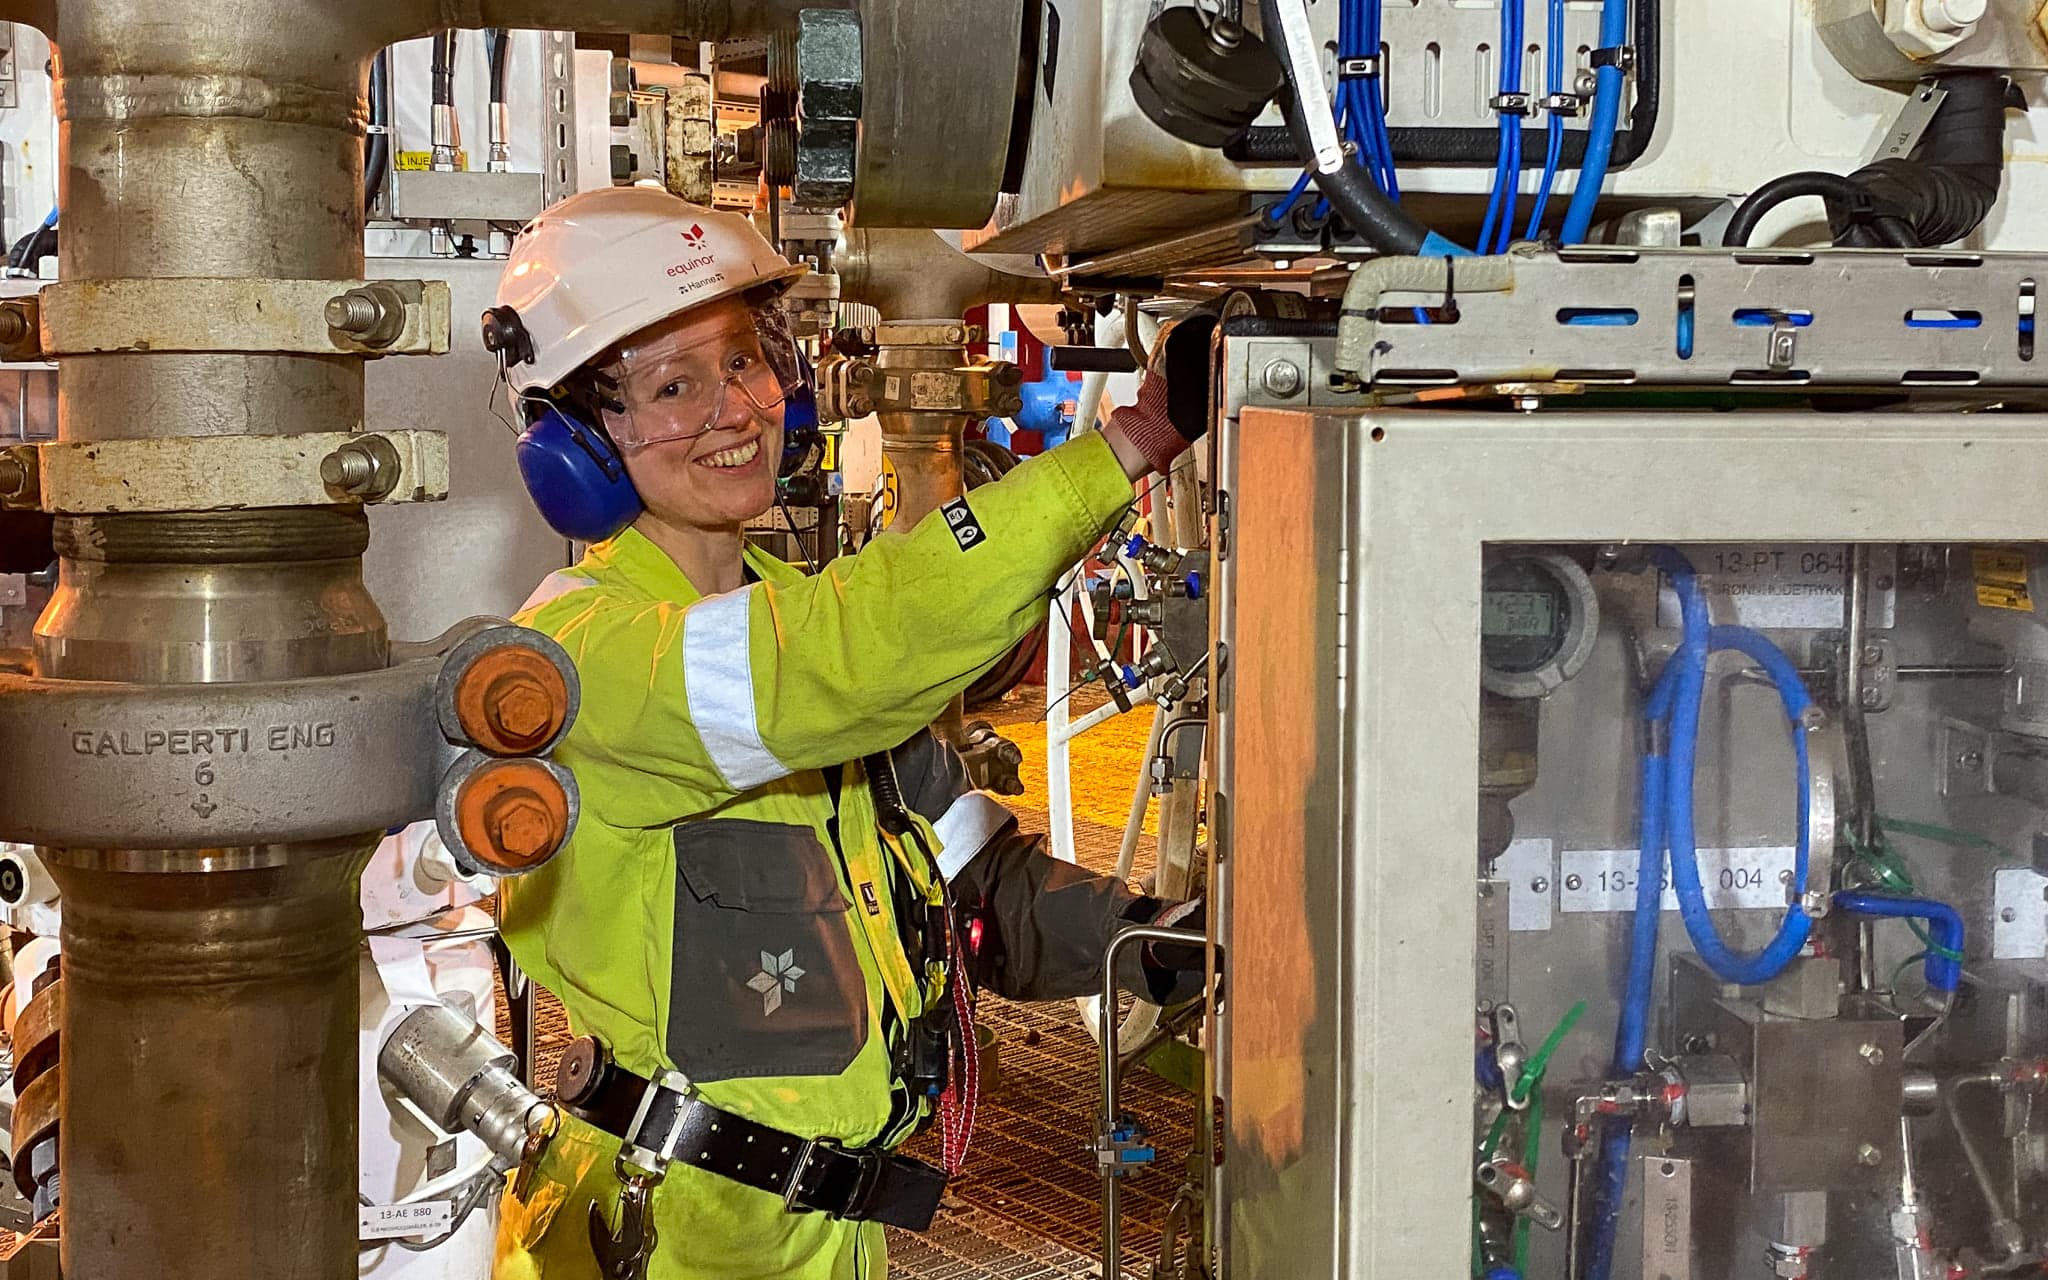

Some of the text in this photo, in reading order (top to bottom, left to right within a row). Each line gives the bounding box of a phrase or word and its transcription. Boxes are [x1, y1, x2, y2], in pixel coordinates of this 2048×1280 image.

[407, 156, 433, 166] INJE
[666, 254, 714, 277] equinor
[687, 276, 717, 291] Hanne
[71, 721, 335, 757] GALPERTI ENG
[194, 760, 215, 786] 6
[1718, 867, 1764, 891] 004
[380, 1206, 432, 1220] 13-AE 880
